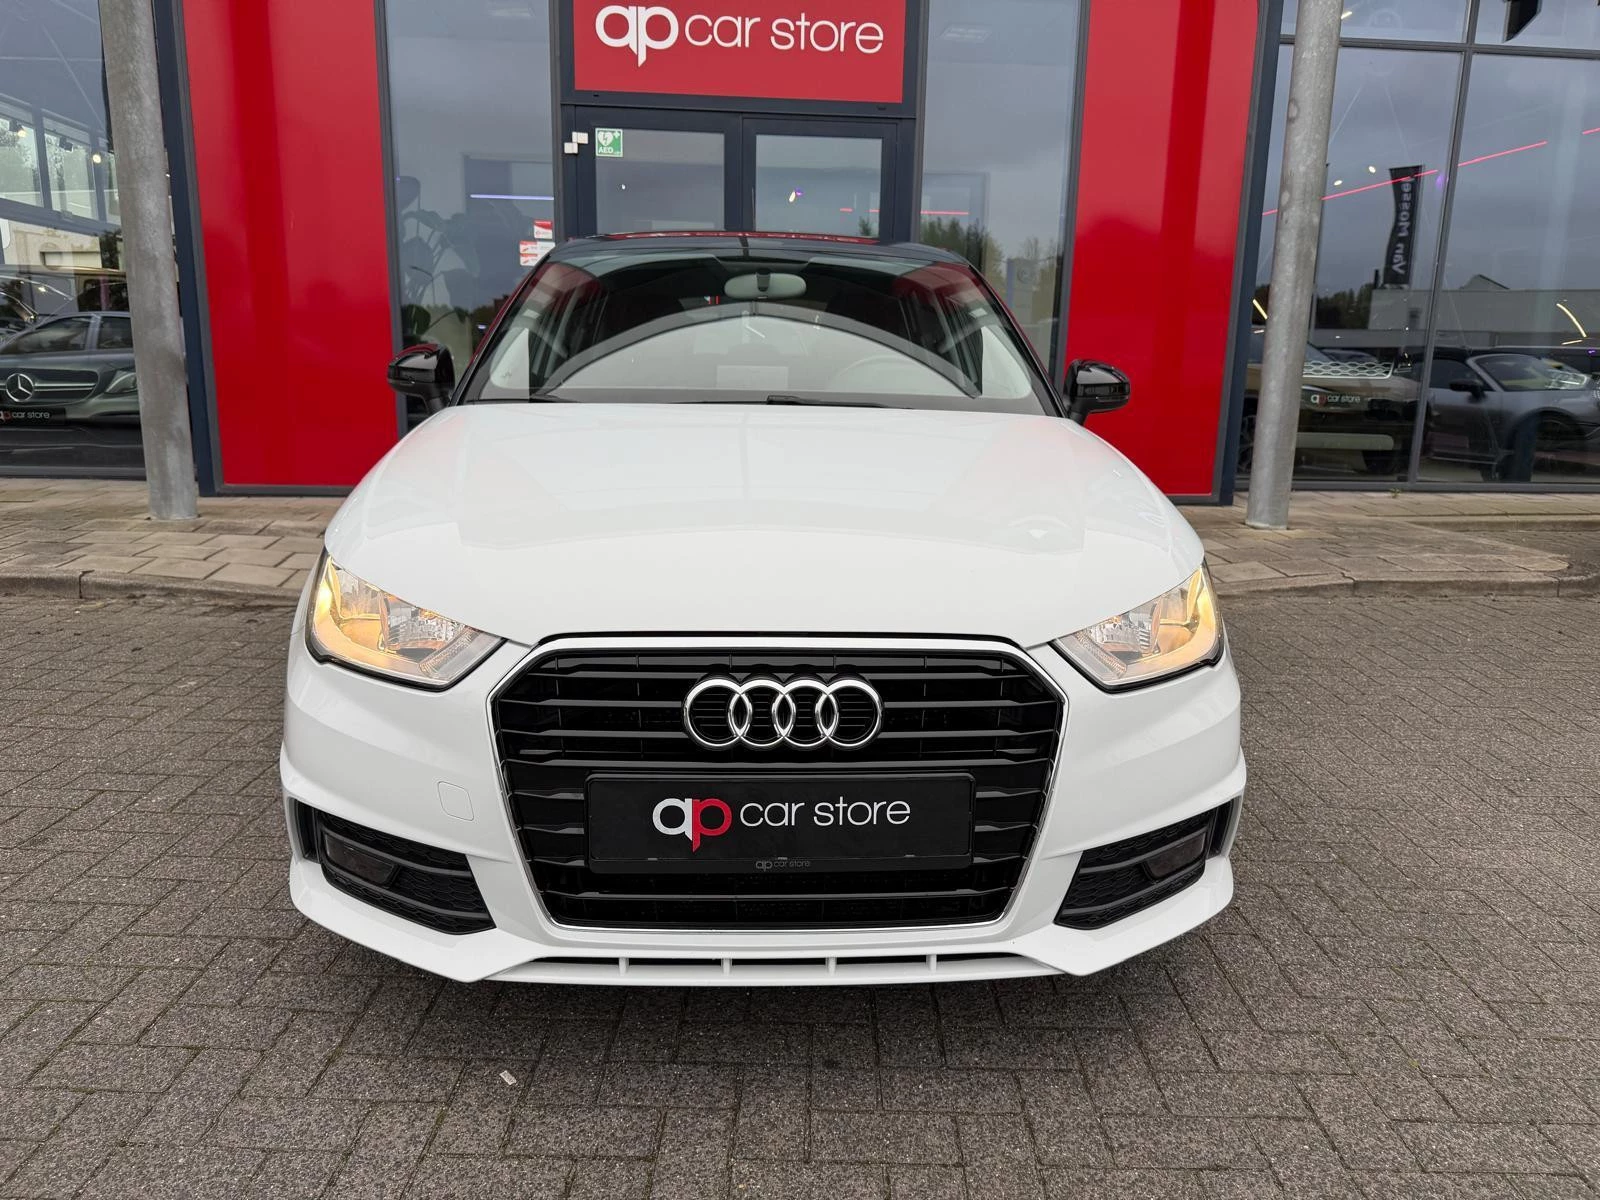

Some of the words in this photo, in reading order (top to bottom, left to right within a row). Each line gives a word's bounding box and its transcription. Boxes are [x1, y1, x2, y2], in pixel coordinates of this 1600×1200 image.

[595, 5, 679, 67] ap
[685, 14, 761, 48] car
[770, 12, 884, 54] store
[598, 146, 614, 154] AED
[12, 411, 25, 419] car
[27, 410, 50, 419] store
[653, 797, 732, 852] ap
[740, 802, 805, 827] car
[813, 796, 911, 827] store
[789, 859, 811, 868] store
